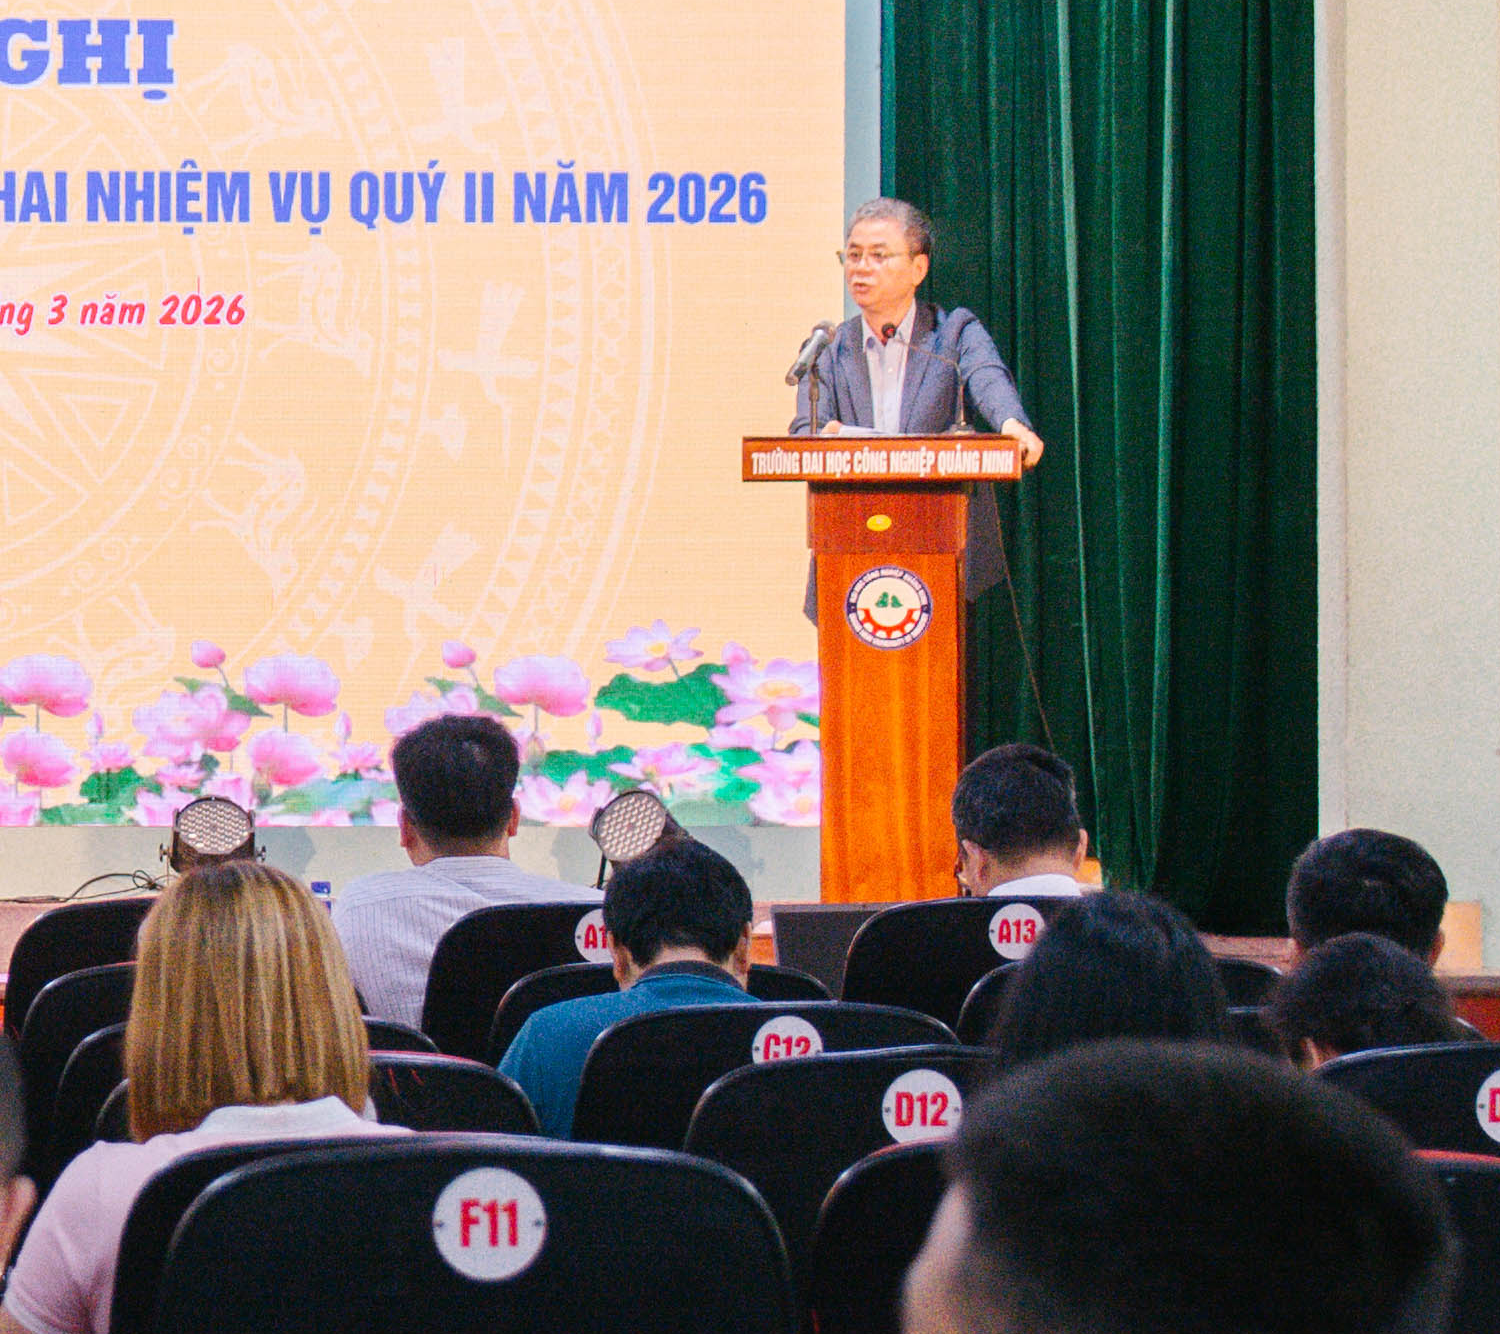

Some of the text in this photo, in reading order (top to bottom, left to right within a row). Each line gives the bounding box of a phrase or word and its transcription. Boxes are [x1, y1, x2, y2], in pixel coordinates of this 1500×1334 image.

[86, 159, 250, 235] NHIỆM
[269, 171, 331, 235] VỤ
[350, 160, 446, 230] QUÝ
[464, 172, 494, 223] II
[514, 160, 629, 224] NĂM
[646, 172, 768, 224] 2026
[49, 295, 67, 325] 3
[80, 296, 145, 325] năm
[160, 295, 245, 325] 2026
[752, 448, 799, 473] TRƯỜNG
[826, 451, 851, 476] HỌC
[854, 447, 887, 473] CÔNG
[890, 447, 935, 476] NGHIỆP
[938, 444, 980, 474] QUẢNG
[982, 451, 1014, 473] NINH
[584, 924, 607, 948] A1
[997, 918, 1037, 944] A13
[895, 1091, 948, 1127] D12
[460, 1198, 518, 1248] F11
